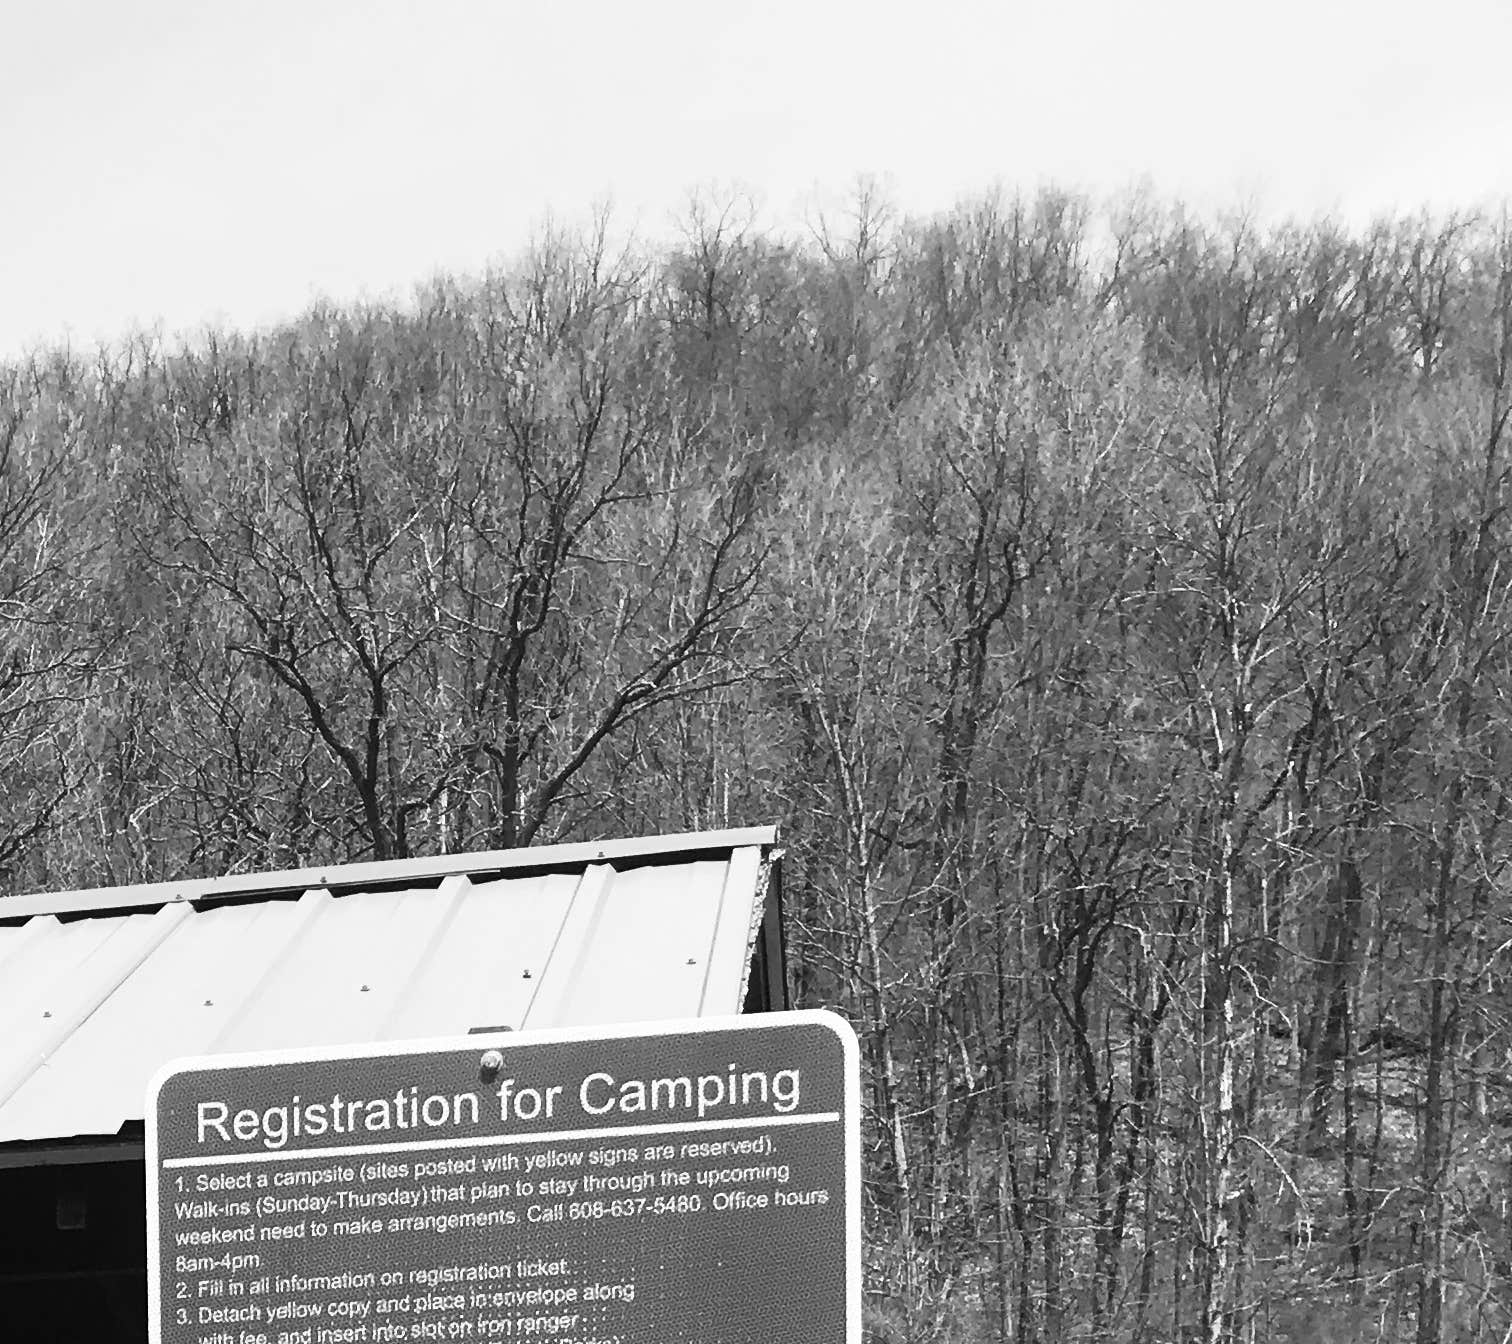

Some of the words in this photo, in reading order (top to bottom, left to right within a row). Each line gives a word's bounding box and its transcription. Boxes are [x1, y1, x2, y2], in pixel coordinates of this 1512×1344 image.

[196, 1086, 479, 1149] Registration
[496, 1078, 561, 1122] for
[579, 1063, 801, 1118] Camping
[175, 1176, 189, 1193] 1.
[196, 1172, 252, 1192] Select
[256, 1174, 268, 1188] a
[274, 1165, 355, 1188] campsite
[360, 1161, 409, 1183] (sites
[414, 1156, 476, 1179] posted
[482, 1152, 519, 1171] with
[524, 1149, 583, 1173] yellow
[588, 1145, 638, 1167] signs
[644, 1145, 675, 1160] are
[681, 1135, 777, 1158] reserved).
[175, 1200, 251, 1220] Walk-ins
[471, 1181, 510, 1203] plan
[516, 1179, 534, 1197] to
[539, 1175, 579, 1197] stay
[583, 1169, 655, 1193] through
[660, 1168, 690, 1186] the
[696, 1163, 789, 1189] upcoming
[175, 1224, 255, 1246] weekend
[260, 1221, 305, 1242] need
[310, 1221, 328, 1237] to
[333, 1215, 383, 1235] make
[527, 1204, 564, 1223] Call
[712, 1190, 769, 1212] Office
[774, 1188, 829, 1207] hours
[176, 1281, 192, 1299] 2.
[198, 1279, 223, 1298] Fill
[229, 1278, 244, 1296] in
[249, 1277, 270, 1295] all
[275, 1270, 375, 1293] information
[380, 1270, 403, 1287] on
[409, 1262, 512, 1287] registration
[176, 1308, 192, 1325] 3.
[198, 1303, 261, 1325] Detach
[265, 1301, 323, 1324] yellow
[327, 1300, 372, 1320] copy
[376, 1294, 410, 1314] and
[414, 1293, 465, 1315] place
[470, 1290, 487, 1307] in
[492, 1286, 578, 1308] envelope
[583, 1283, 635, 1303] along
[317, 1323, 367, 1343] insert
[372, 1322, 405, 1342] into
[411, 1321, 445, 1339] slot
[448, 1320, 472, 1338] on
[478, 1315, 512, 1336] iron
[517, 1313, 579, 1334] ranger
